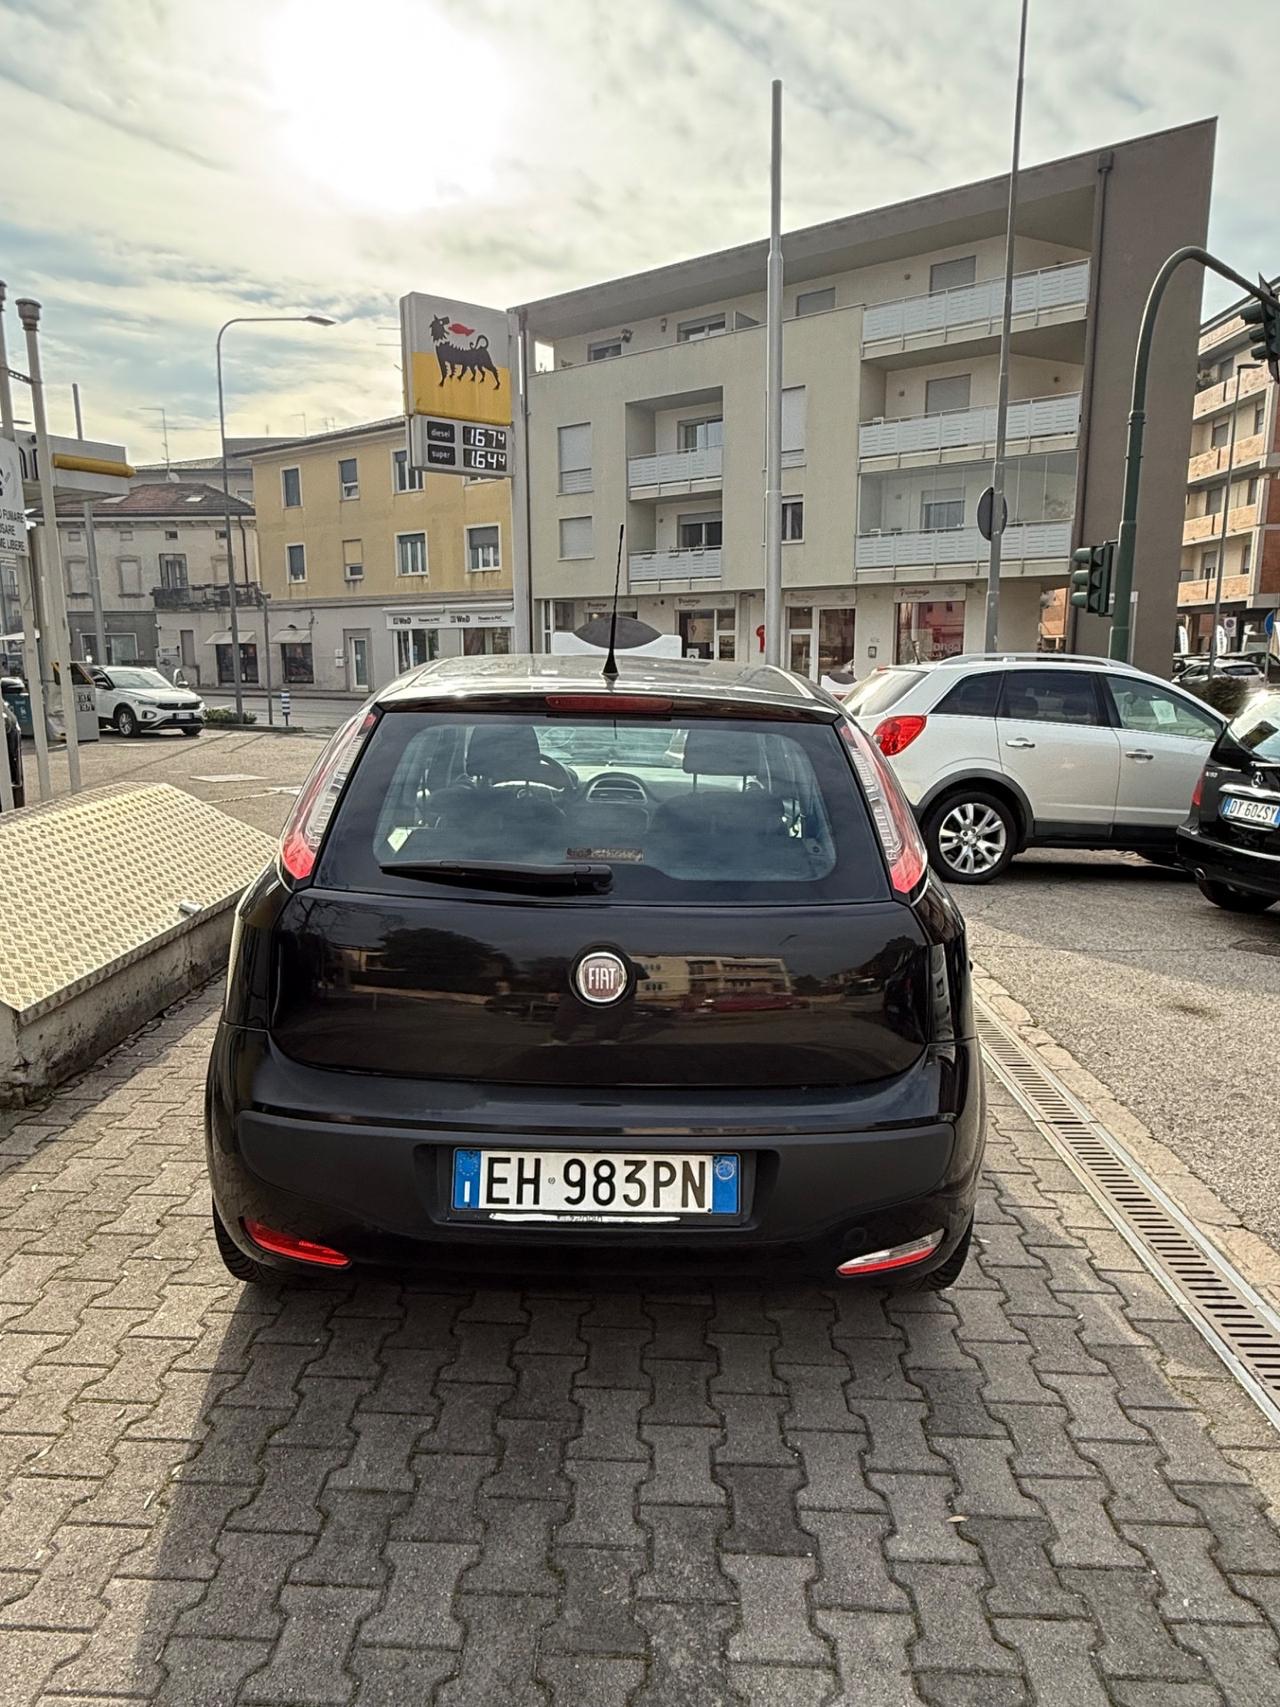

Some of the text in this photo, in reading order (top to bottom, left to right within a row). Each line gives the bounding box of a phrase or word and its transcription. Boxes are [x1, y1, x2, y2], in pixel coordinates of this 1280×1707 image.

[431, 428, 451, 438] diesel
[470, 428, 506, 448] 1674
[431, 450, 451, 459] super
[3, 508, 25, 523] FUMARE
[7, 539, 26, 553] LIBERE
[588, 967, 616, 990] FIAT
[486, 1156, 706, 1209] EH 983PN
